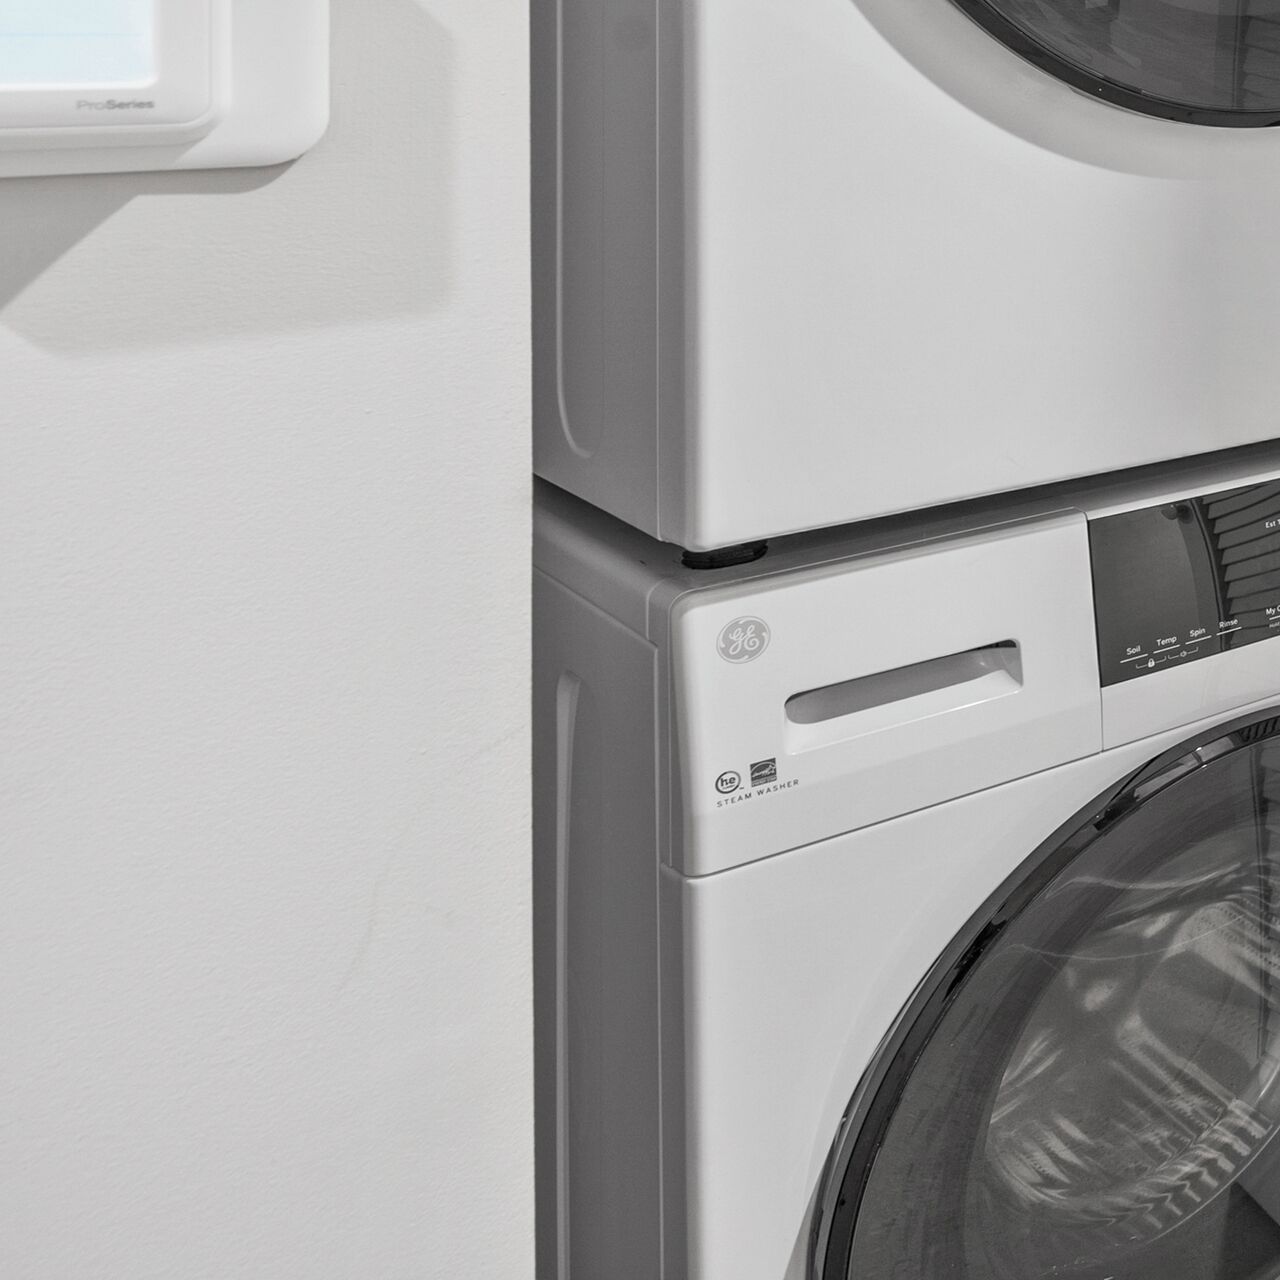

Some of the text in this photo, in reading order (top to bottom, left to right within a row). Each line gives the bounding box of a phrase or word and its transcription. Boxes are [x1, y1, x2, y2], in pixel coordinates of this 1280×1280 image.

[76, 99, 154, 110] ProSeries
[1266, 606, 1276, 617] My
[1219, 618, 1239, 629] Rinse
[1190, 628, 1206, 638] Spin
[1156, 636, 1177, 647] Temp
[1126, 645, 1141, 655] Soil
[720, 777, 736, 786] he
[716, 779, 799, 808] STEAM WASHER
